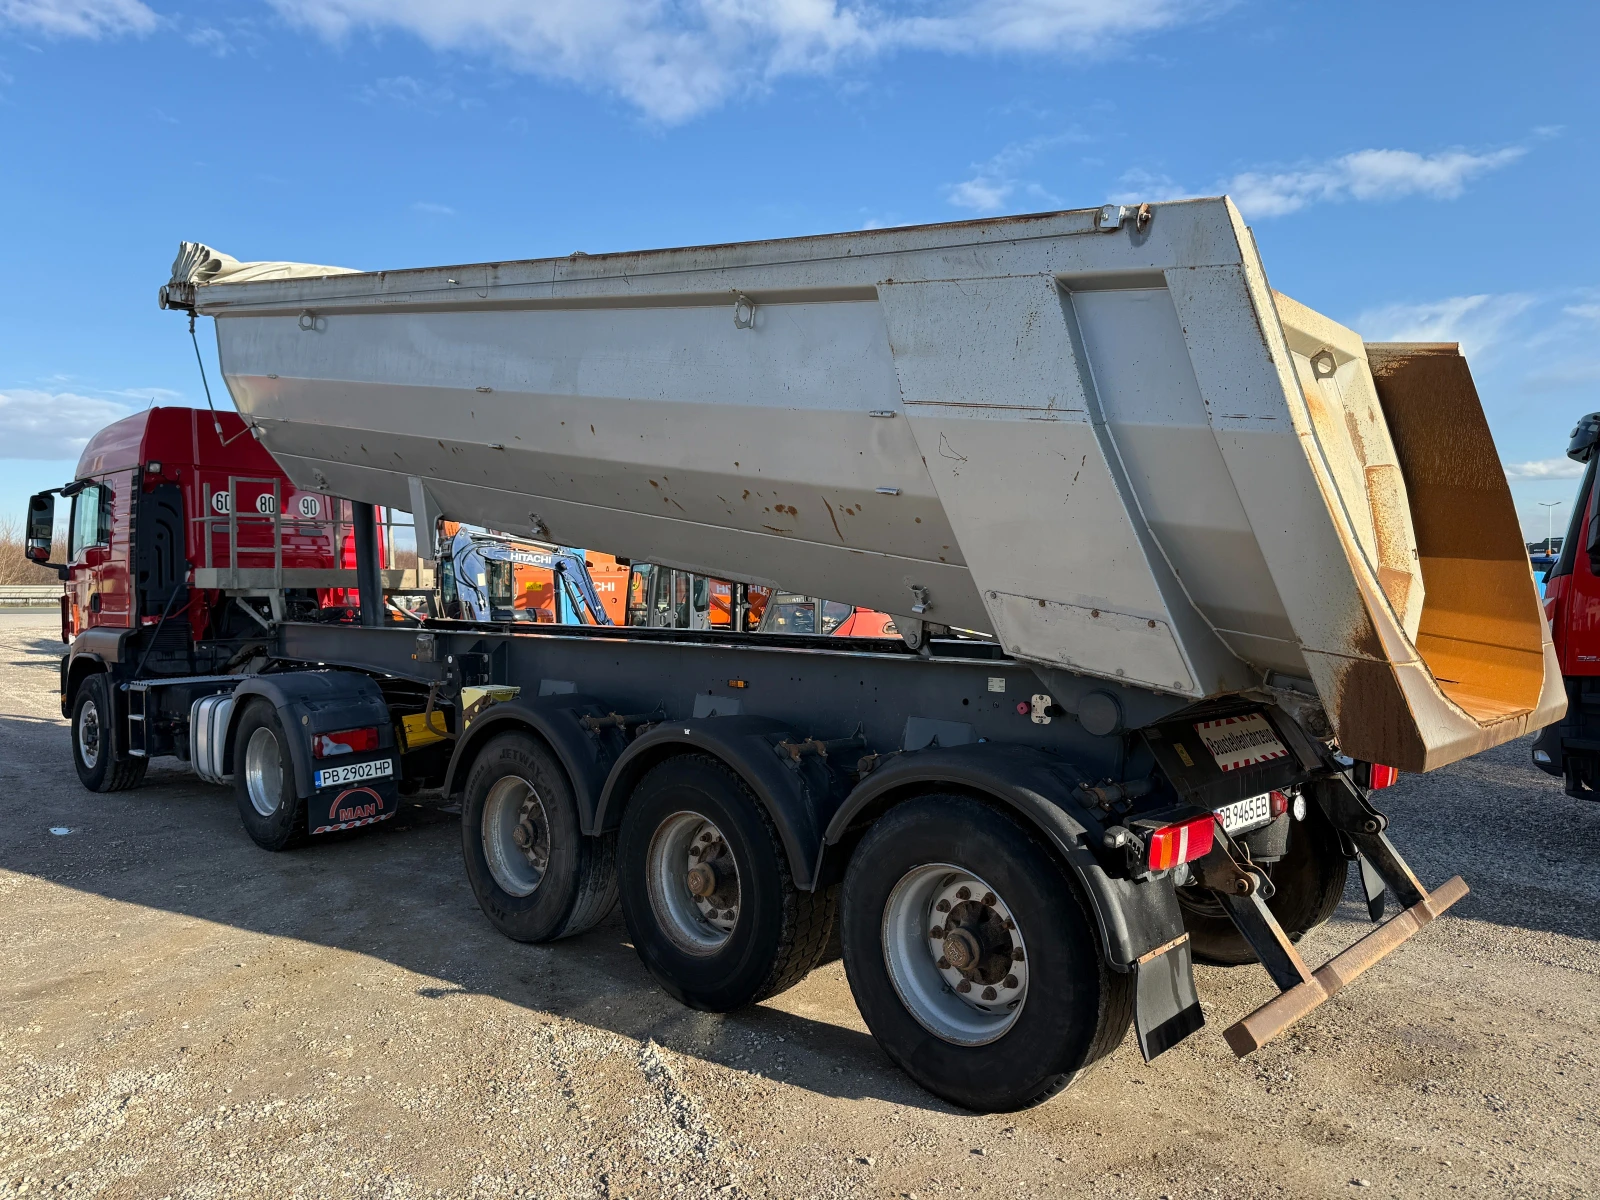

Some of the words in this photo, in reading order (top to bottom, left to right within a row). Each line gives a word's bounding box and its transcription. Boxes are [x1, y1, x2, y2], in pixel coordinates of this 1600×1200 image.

[215, 493, 230, 511] 60
[260, 495, 275, 513] 80
[302, 498, 317, 515] 90
[510, 552, 552, 565] HITACHI
[1206, 728, 1279, 756] Baustellenfahrzeug
[323, 769, 340, 785] PB
[342, 764, 373, 781] 2902
[374, 761, 390, 775] HP
[500, 748, 542, 780] JETWAY
[339, 803, 376, 822] MAN
[1233, 799, 1255, 826] 9465
[1255, 795, 1268, 818] EB
